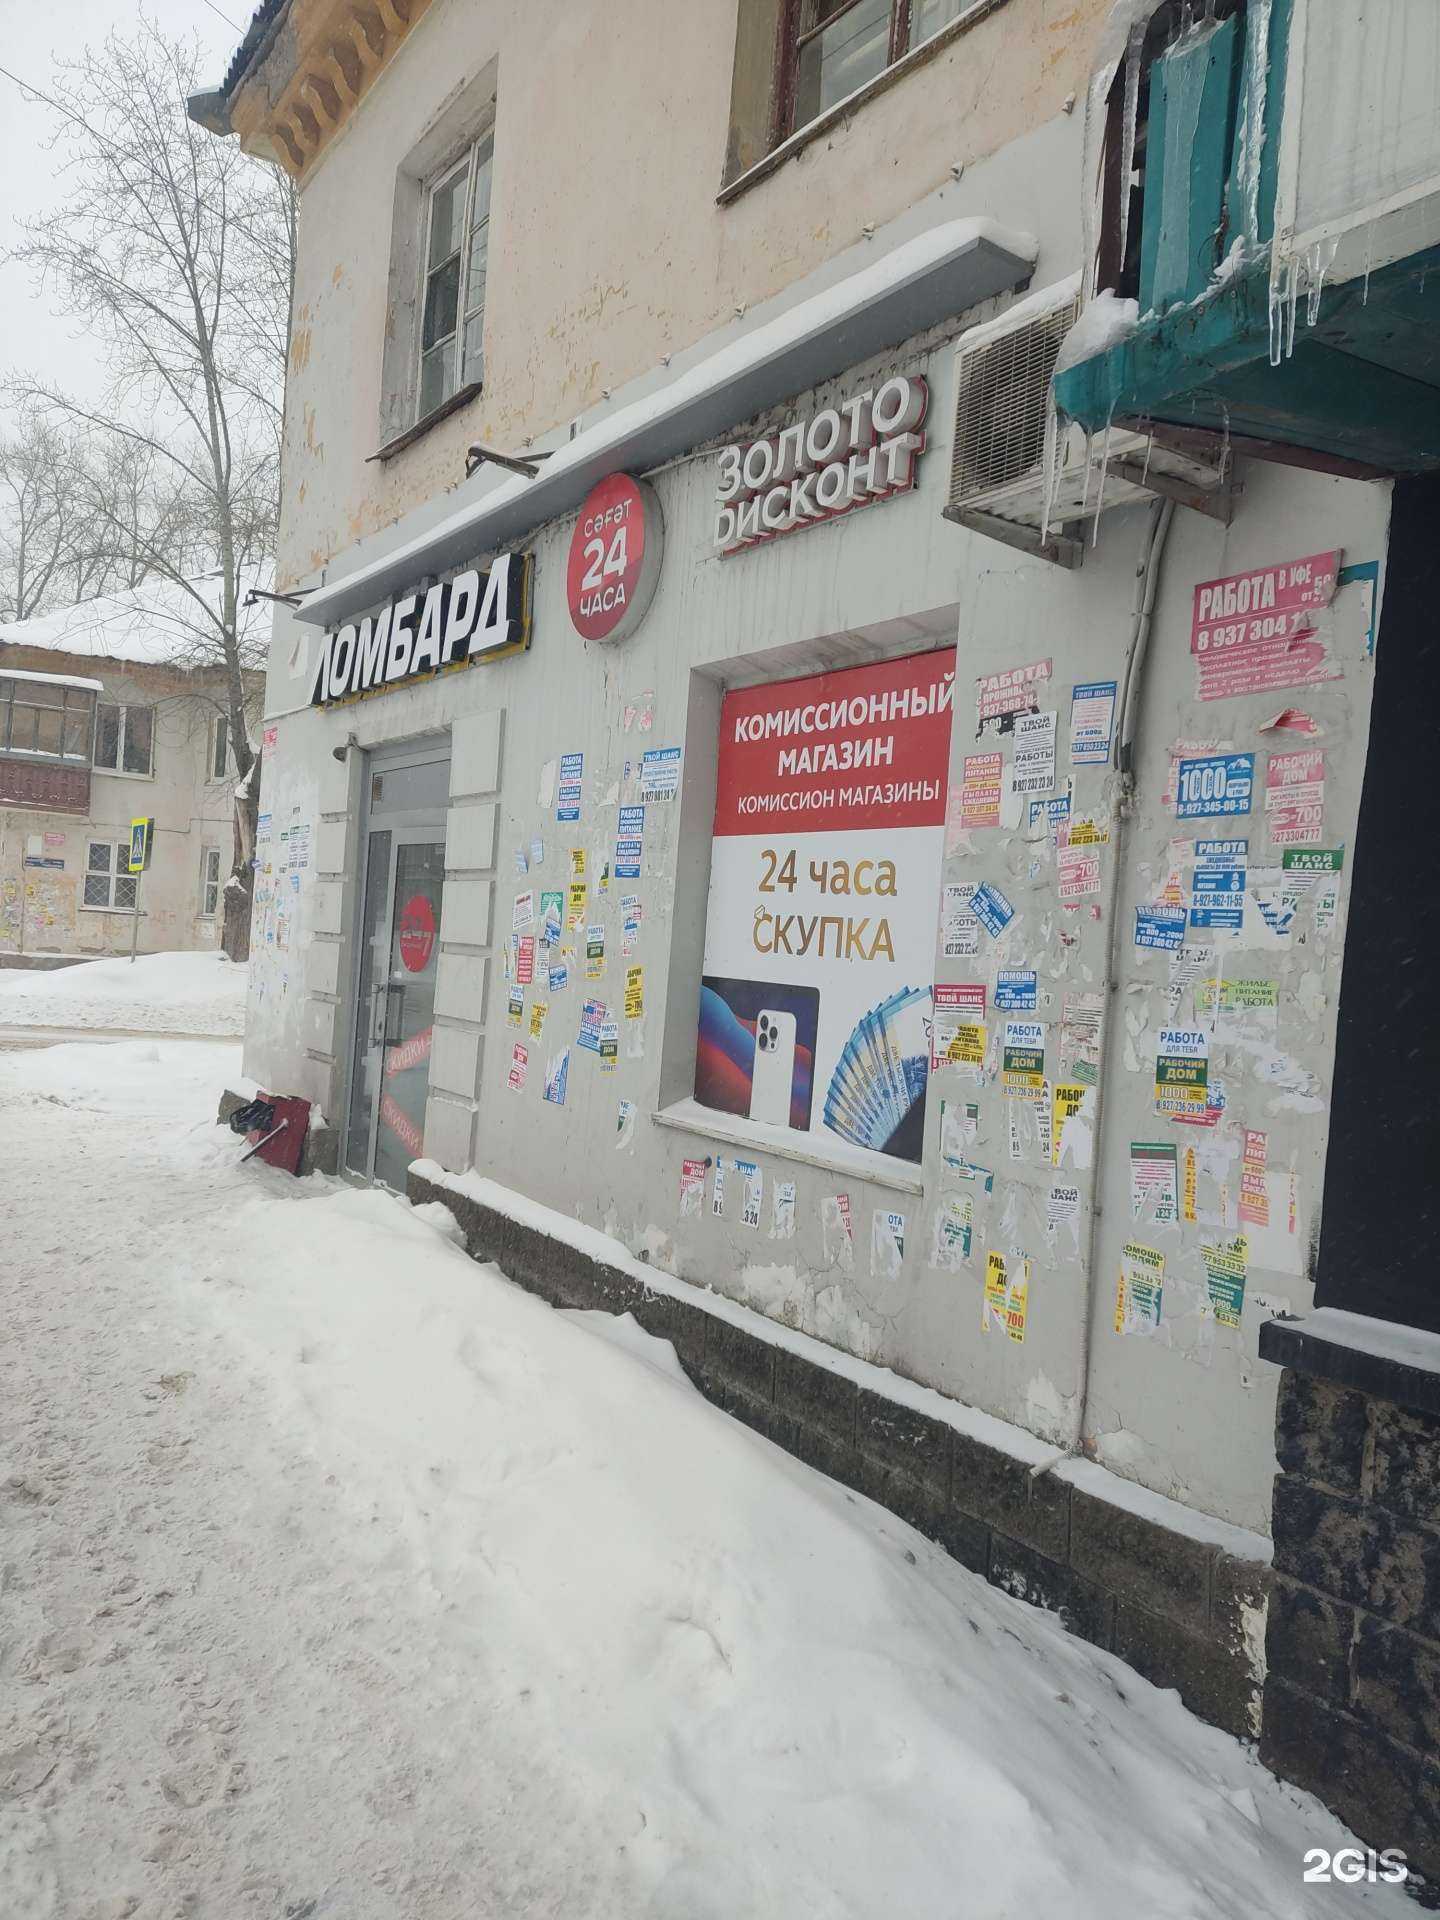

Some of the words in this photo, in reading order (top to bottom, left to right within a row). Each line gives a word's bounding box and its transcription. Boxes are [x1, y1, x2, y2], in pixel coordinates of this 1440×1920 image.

[715, 376, 920, 502] ЗОЛОТО
[580, 527, 627, 592] 24
[1198, 573, 1276, 622] РАБОТА
[1290, 564, 1312, 587] УФЕ
[579, 583, 626, 618] ЧАСА
[307, 553, 511, 706] ЛОМБАРД
[1197, 631, 1209, 650] 8
[1214, 624, 1246, 648] 937
[1250, 615, 1287, 641] 304
[977, 662, 1050, 691] РАБОТА
[735, 672, 956, 743] КОМИССИОННЫЙ
[1020, 723, 1051, 732] ШАНС
[1023, 716, 1050, 727] ТВОЙ
[562, 755, 581, 767] РАБОТА
[777, 736, 894, 776] МАГАЗИН
[966, 754, 1000, 766] РАБОТА
[1015, 751, 1054, 763] РАБОТЫ
[966, 767, 1000, 777] ПИТАНИЕ
[1282, 769, 1307, 785] ДОМ
[1012, 780, 1017, 792] 8
[1181, 767, 1226, 801] 1000
[738, 789, 834, 814] КОМИССИОН
[839, 780, 940, 808] МАГАЗИНЫ
[620, 808, 643, 820] РАБОТА
[1199, 841, 1246, 853] РАБОТА
[1292, 853, 1334, 862] ТВОЙ
[1290, 861, 1334, 869] ШАНС
[758, 849, 798, 893] 24
[809, 860, 898, 897] часа
[1137, 906, 1186, 920] ПОМОЩЬ
[753, 907, 896, 963] СКУПКА
[998, 971, 1036, 981] ПОМОЩЬ
[936, 993, 958, 1003] ТВОЙ
[960, 995, 983, 1003] ШАНС
[1007, 1025, 1042, 1036] РАБОТА
[1160, 1031, 1205, 1044] РАБОТА
[1166, 1045, 1180, 1053] ДЛЯ
[1182, 1045, 1198, 1053] ТЕБЯ
[1011, 1057, 1035, 1068] ДОМ
[1159, 1058, 1206, 1069] РАБОЧИЙ
[1166, 1069, 1197, 1080] ДОМ
[690, 1168, 705, 1177] ДОМ
[1054, 1188, 1078, 1197] ВОЙ
[750, 1211, 758, 1226] 24
[1124, 1244, 1164, 1261] ОМОЩЬ
[1007, 1311, 1024, 1328] 700
